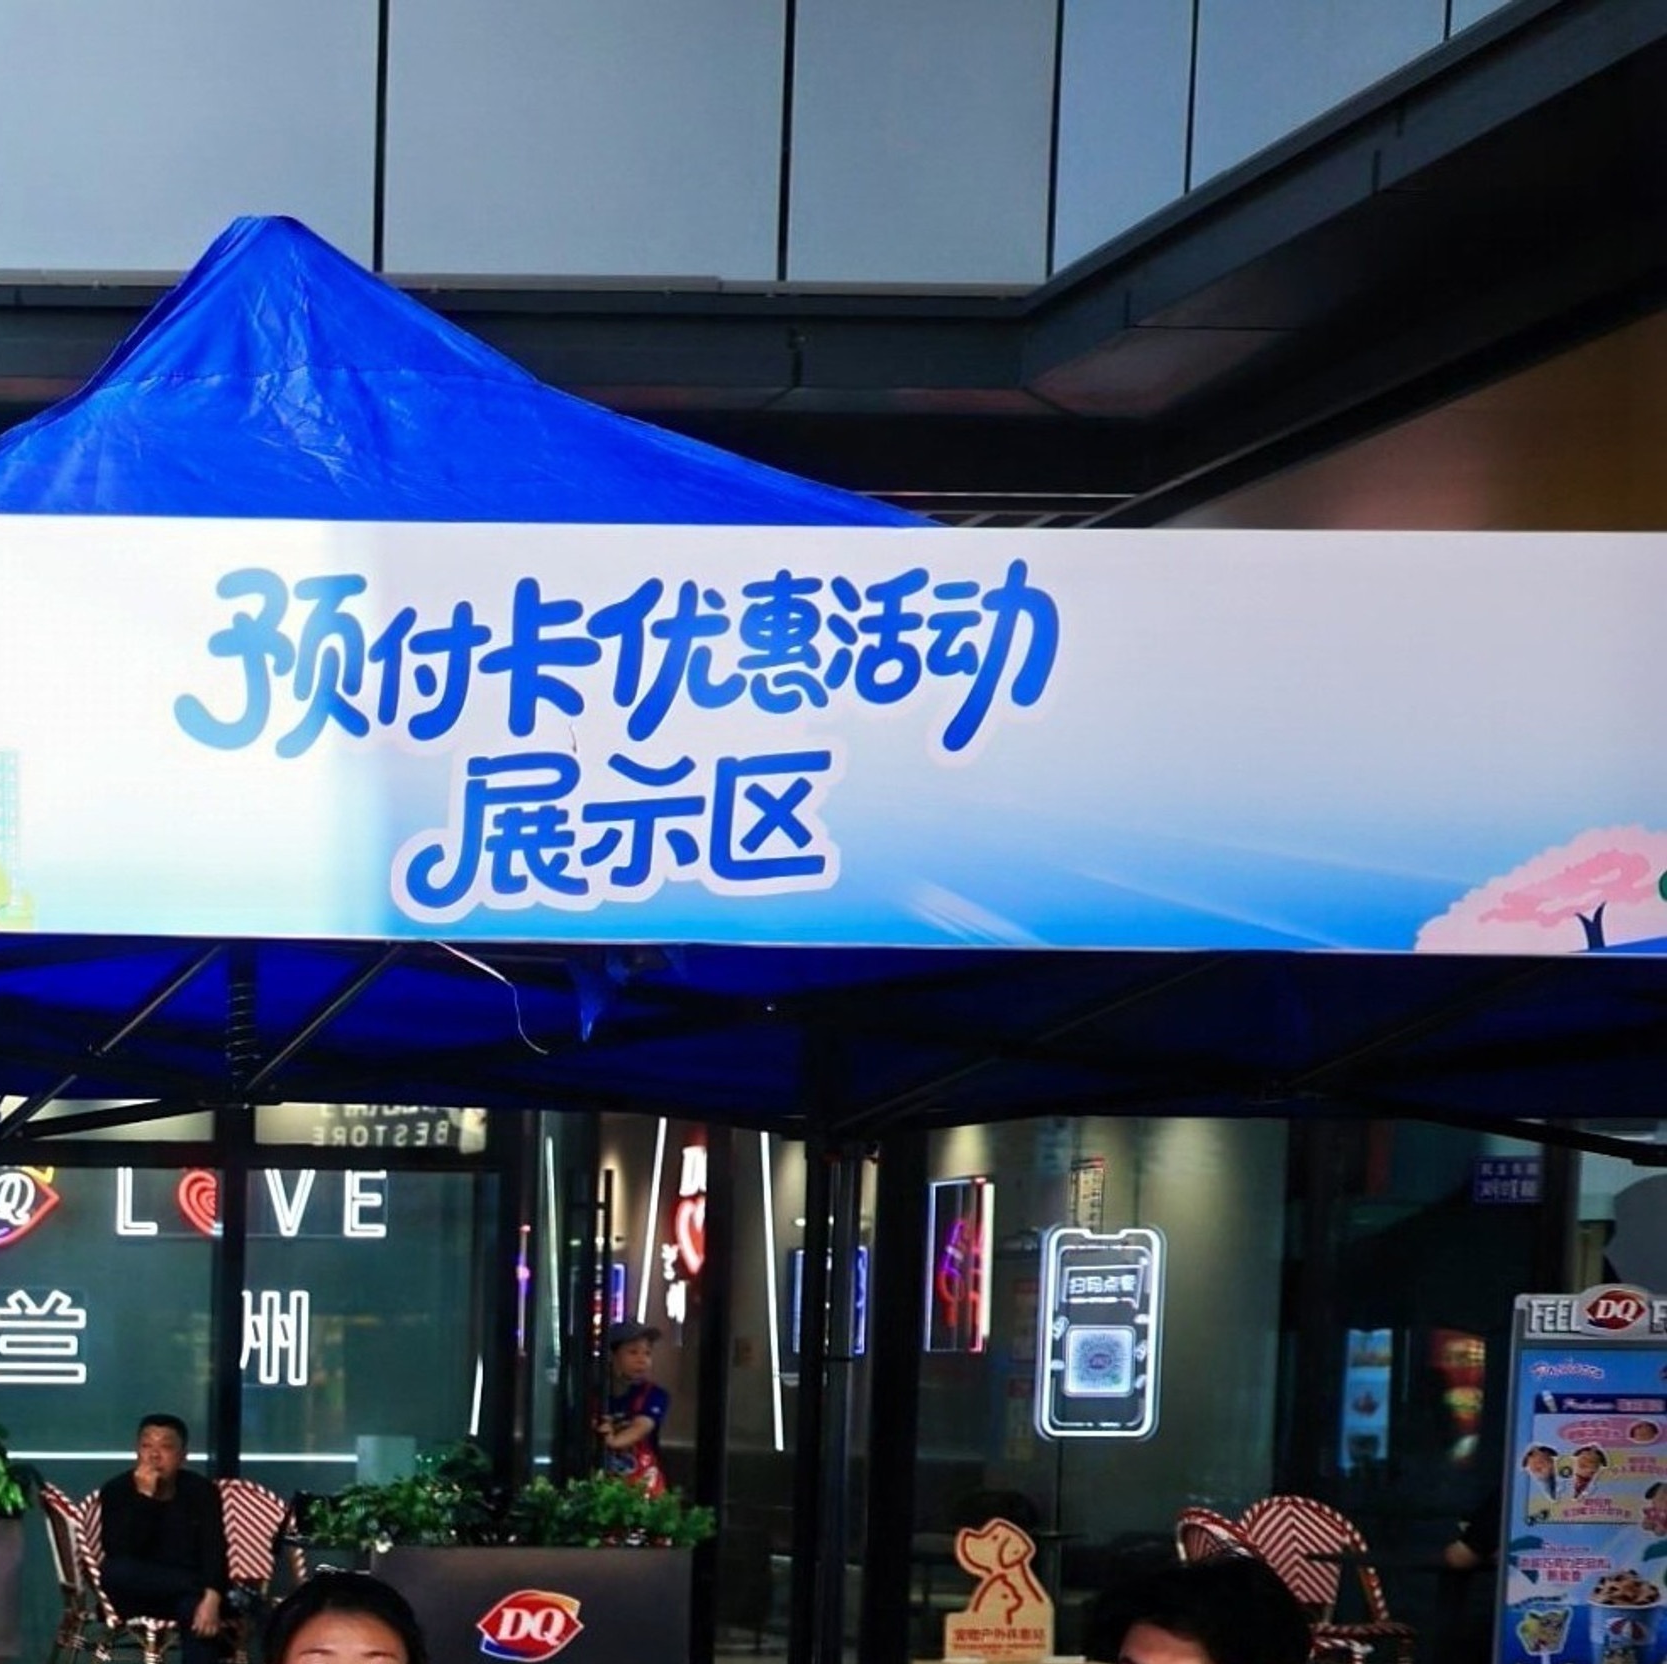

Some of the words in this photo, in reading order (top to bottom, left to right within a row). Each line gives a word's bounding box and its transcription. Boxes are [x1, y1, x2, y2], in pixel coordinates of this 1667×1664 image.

[173, 558, 1060, 759] 预付卡优惠活动
[405, 751, 831, 909] 展示区
[1596, 1299, 1638, 1321] DQ
[497, 1607, 567, 1646] DQ
